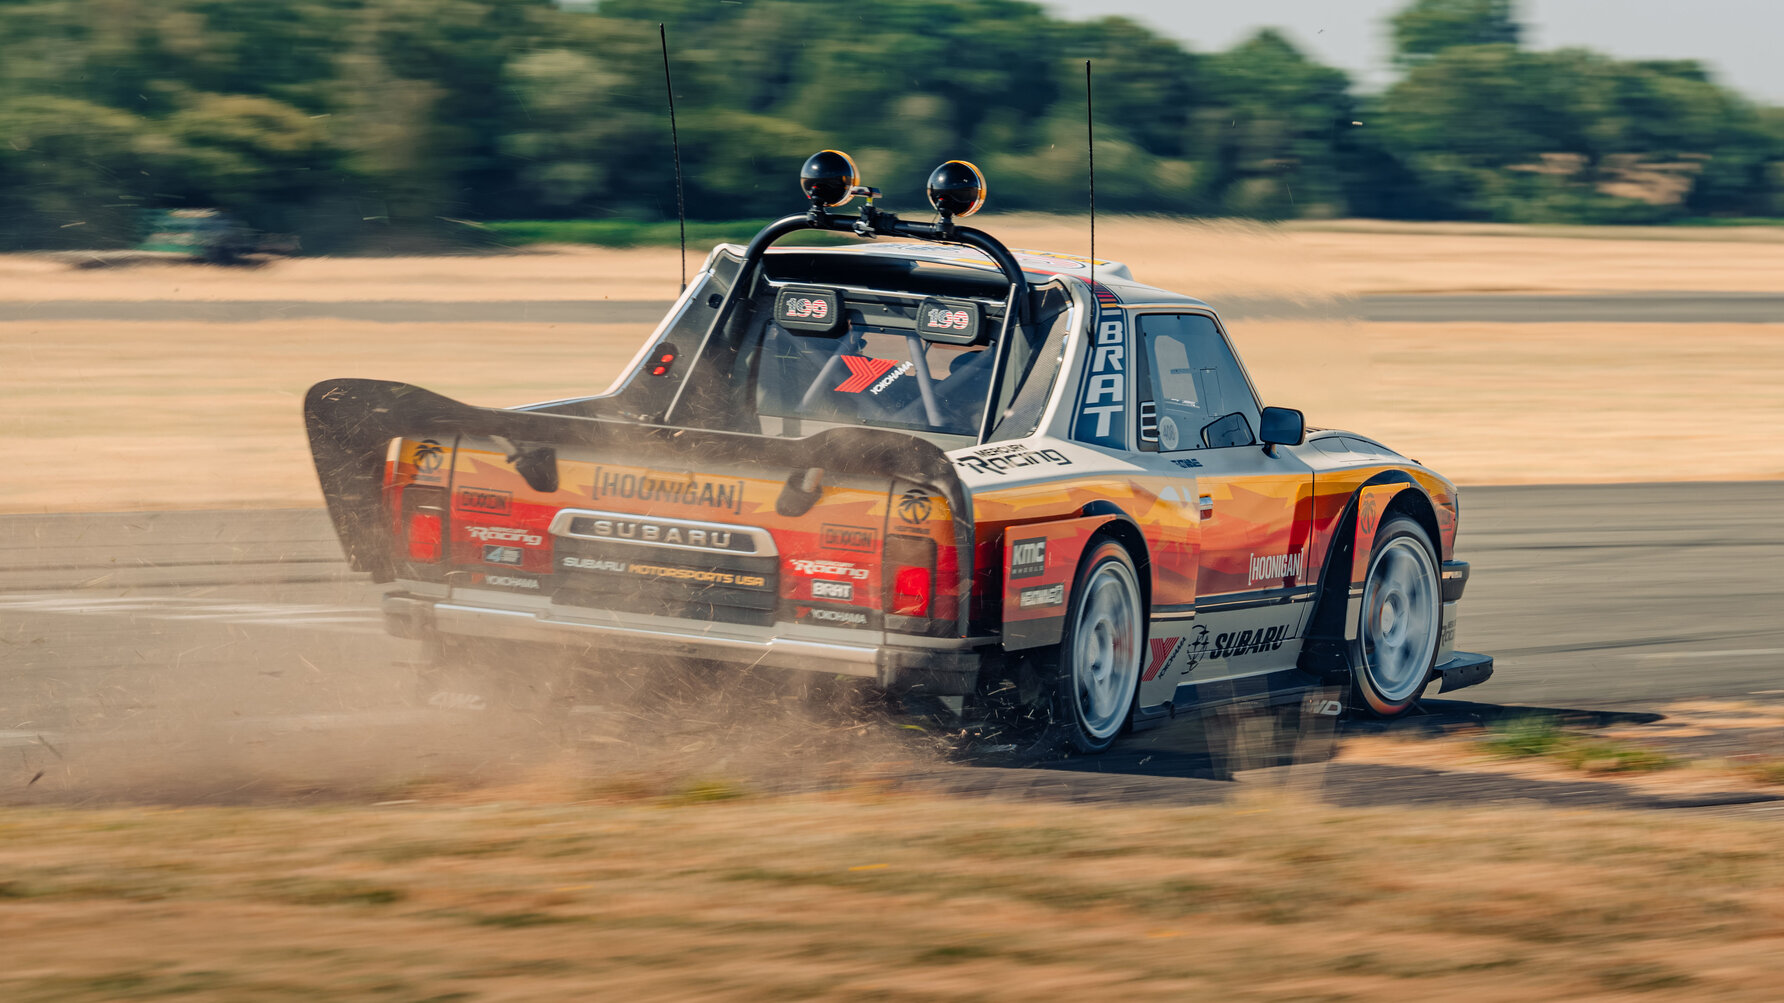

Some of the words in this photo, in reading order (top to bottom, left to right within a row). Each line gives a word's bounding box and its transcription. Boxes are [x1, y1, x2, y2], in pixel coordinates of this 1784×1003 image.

[785, 297, 828, 319] 199
[927, 308, 969, 330] 199
[869, 360, 915, 395] YOKOHAMA
[1083, 320, 1124, 438] BRAT
[973, 443, 1029, 457] MERCURY
[957, 448, 1073, 475] Racing
[464, 526, 543, 546] Racing
[593, 520, 732, 548] SUBARU
[562, 556, 626, 572] SUBARU
[627, 563, 734, 584] MOTORSPORTS
[734, 574, 766, 588] USA
[789, 559, 871, 580] Racing
[485, 574, 541, 589] YOKOHAMA
[812, 582, 852, 599] BRAT
[811, 608, 868, 624] YOKOHAMA
[1209, 624, 1290, 660] SUBARU
[1157, 636, 1187, 680] YOKOHAMA
